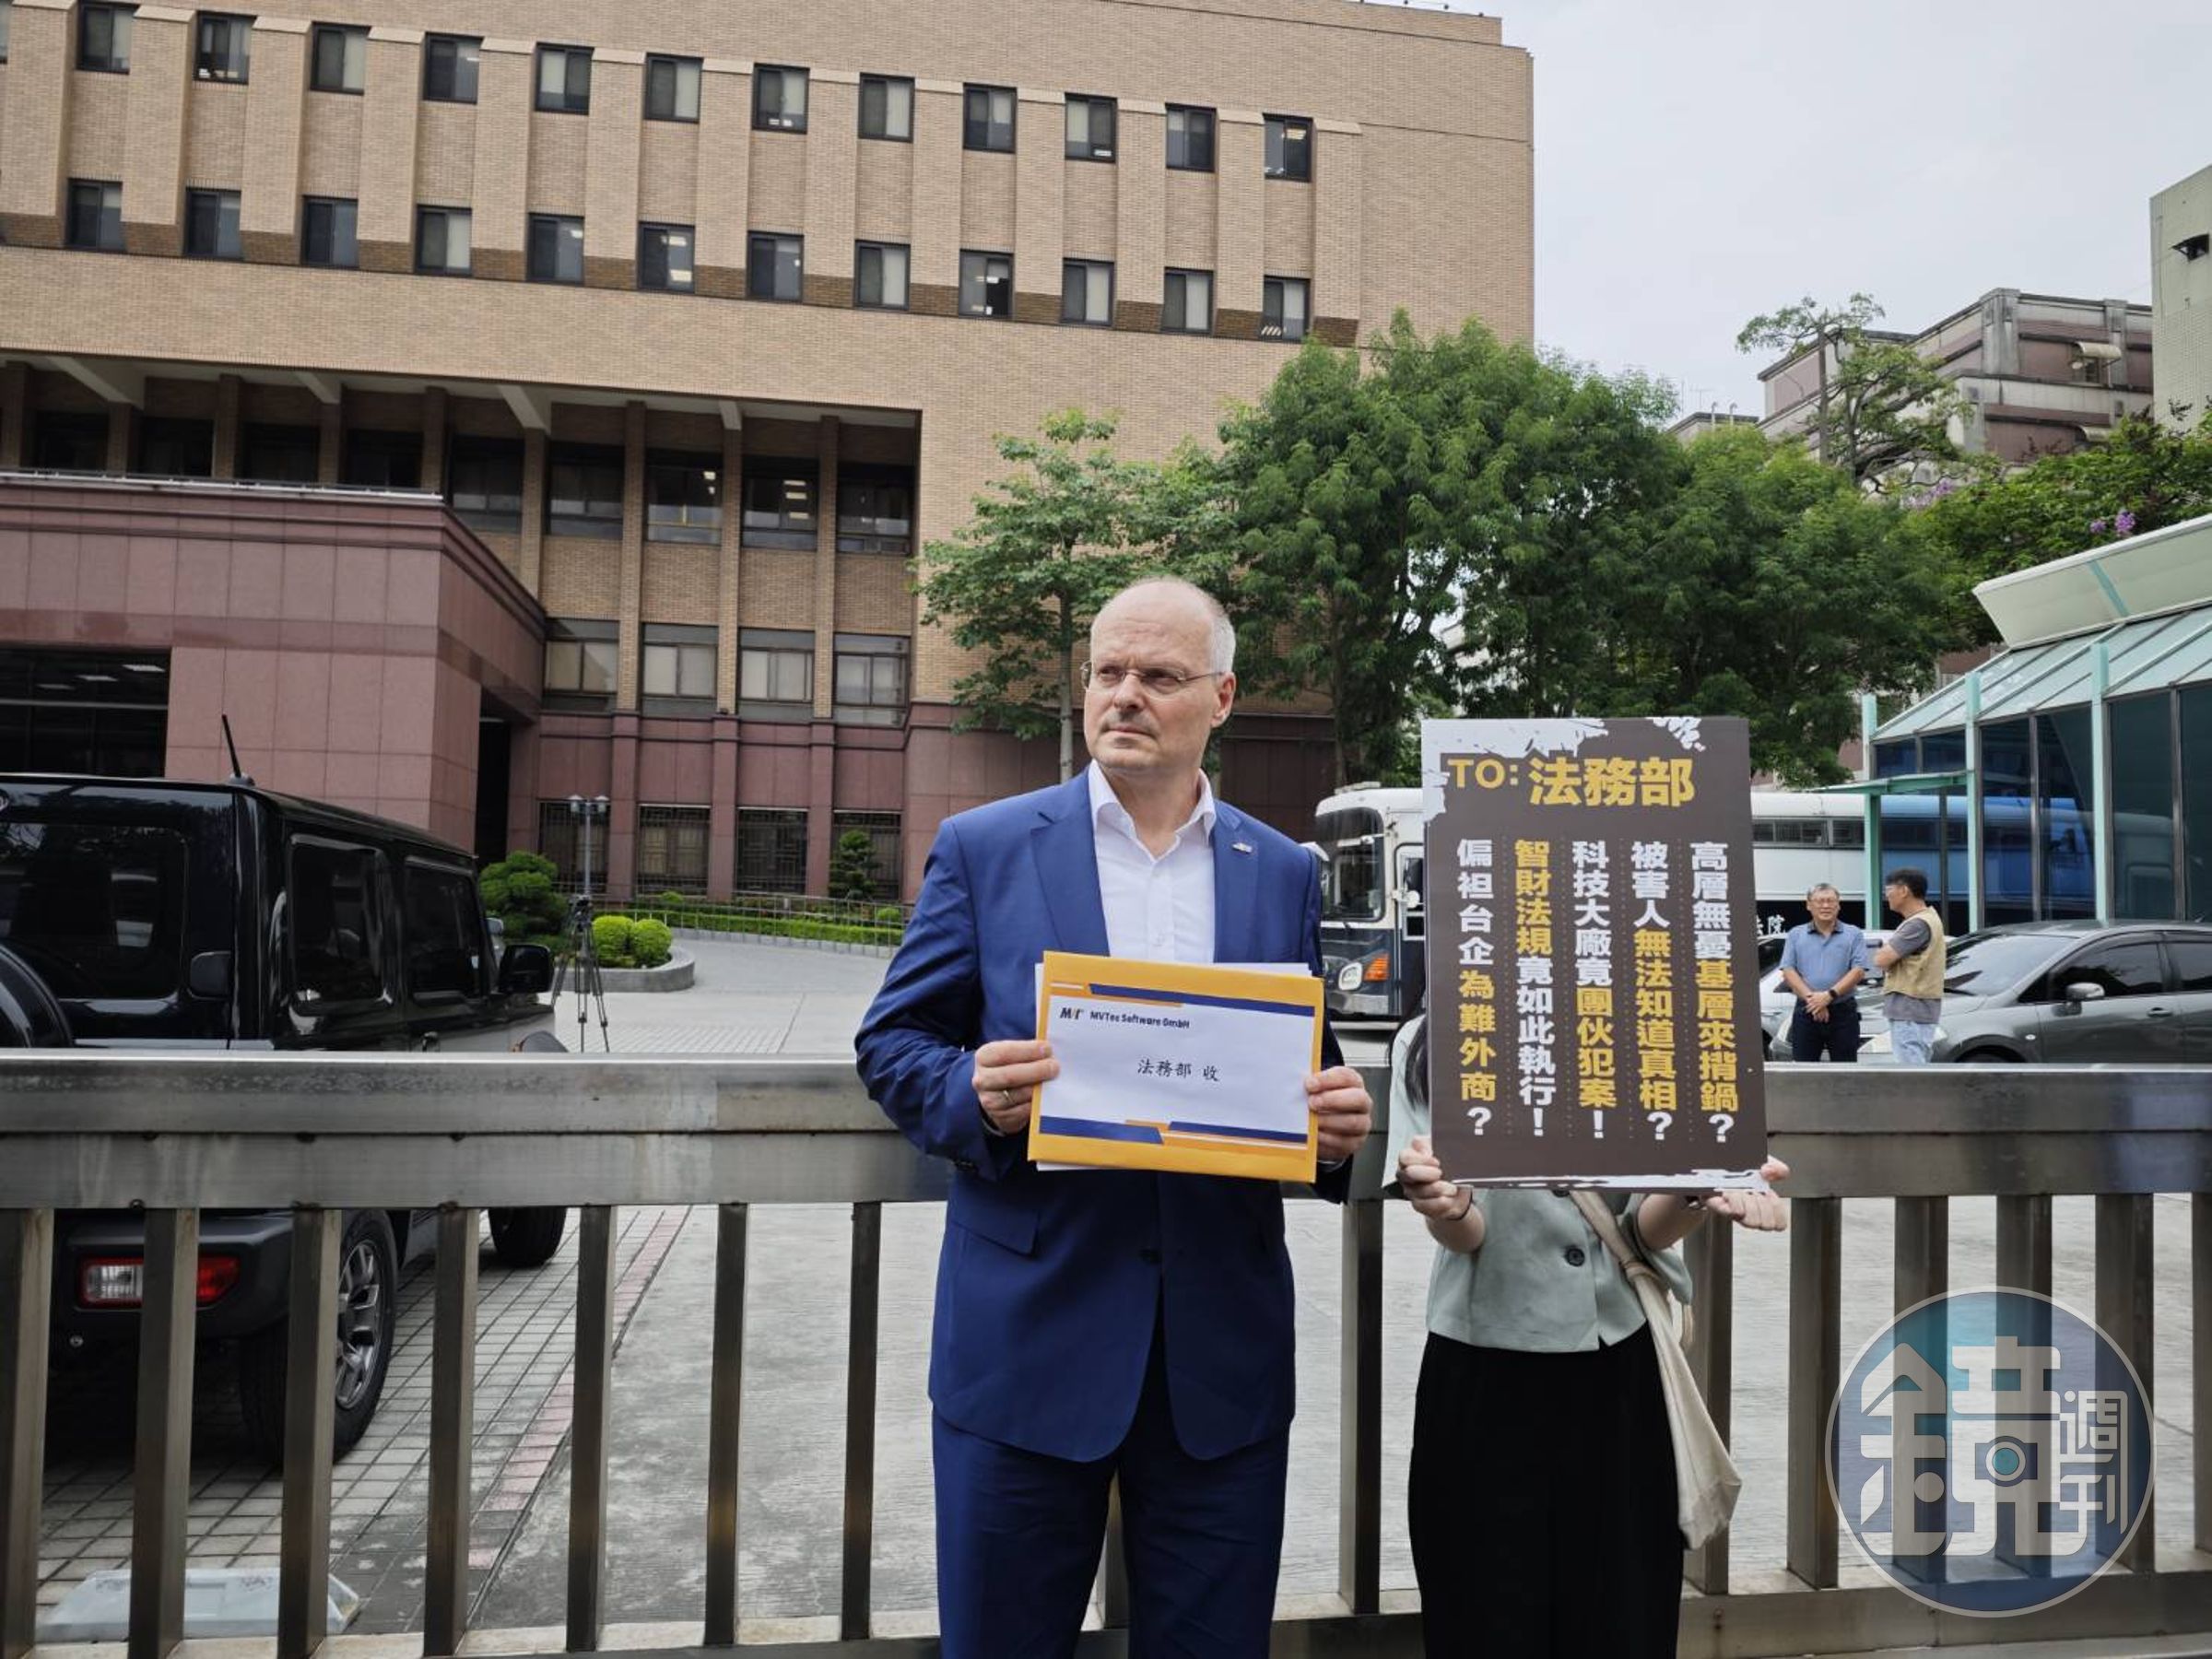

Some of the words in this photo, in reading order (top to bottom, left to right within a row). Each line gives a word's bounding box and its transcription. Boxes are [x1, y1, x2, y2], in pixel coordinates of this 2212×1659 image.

[1448, 758, 1519, 790] TO:
[1528, 756, 1696, 807] 法務部
[1089, 1011, 1120, 1022] MVTec
[1121, 1014, 1161, 1026] Software
[1162, 1018, 1190, 1029] GmbH
[1137, 1058, 1192, 1078] 法務部
[1203, 1065, 1219, 1082] 收
[1456, 838, 1498, 1136] 偏袒台企為難外商？
[1513, 838, 1557, 1137] 智財法規竟如此執行！
[1571, 840, 1618, 1139] 科技大廠竟團伙犯案！
[1630, 840, 1677, 1141] 被害人無法知道真相？
